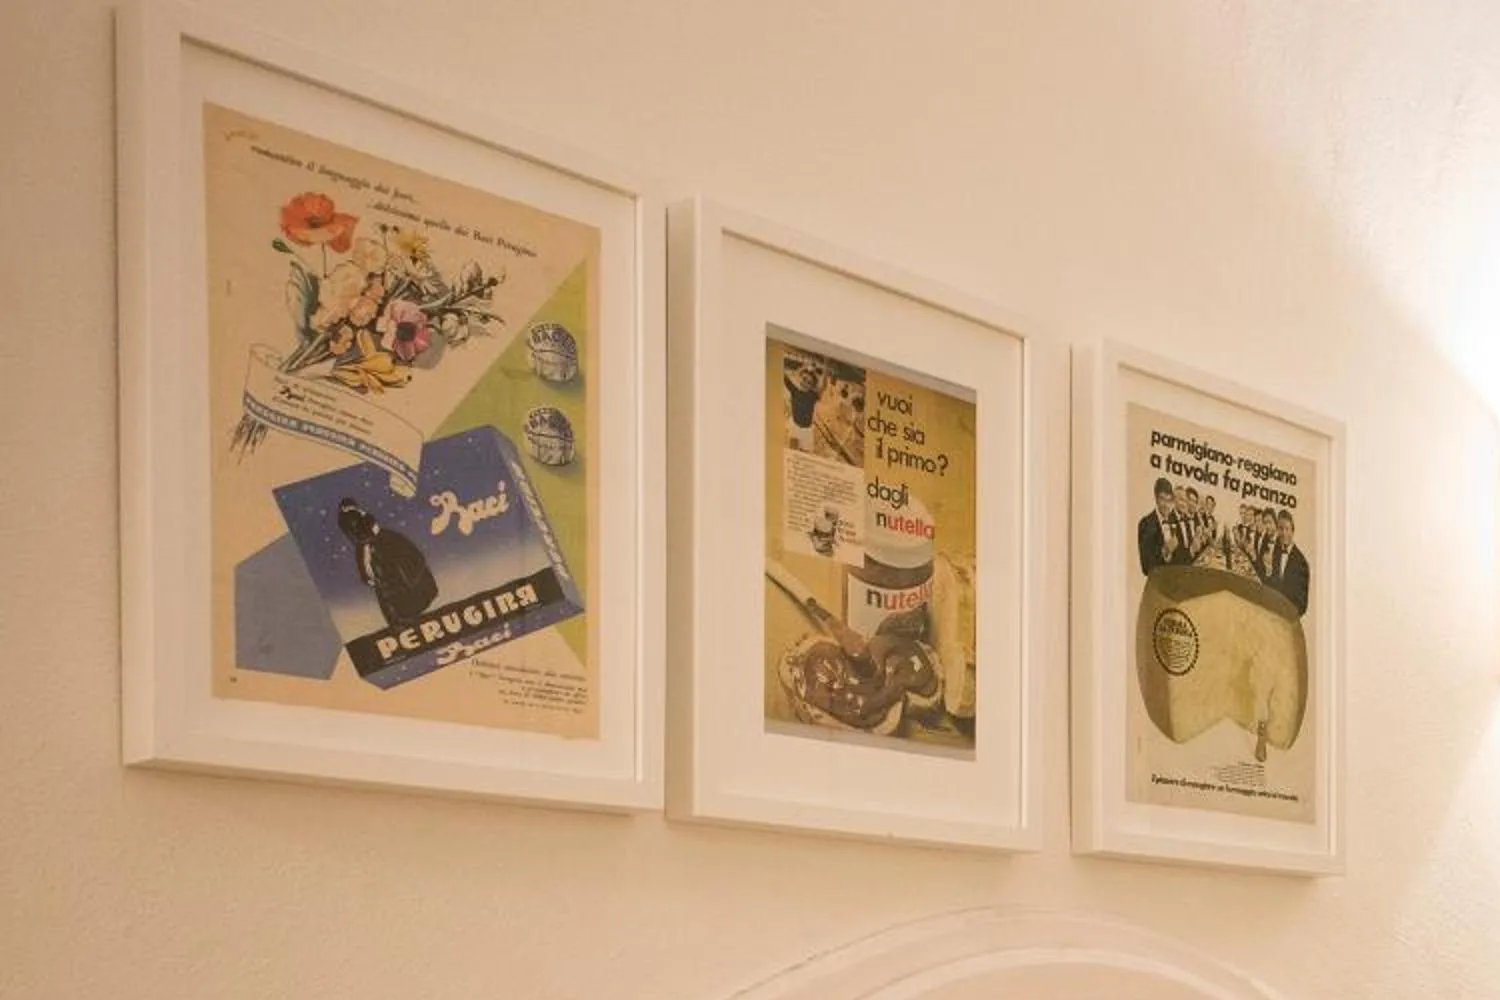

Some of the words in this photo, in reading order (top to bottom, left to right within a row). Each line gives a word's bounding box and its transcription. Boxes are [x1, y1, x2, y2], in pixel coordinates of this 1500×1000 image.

[877, 391, 913, 416] vuoi
[867, 410, 897, 436] che
[903, 420, 925, 446] sia
[887, 447, 949, 477] primo?
[866, 476, 910, 510] dagli
[1150, 453, 1162, 469] a
[1165, 453, 1219, 486] tavola
[1222, 469, 1240, 492] fa
[1241, 480, 1297, 509] pranzo
[876, 511, 936, 540] nutella
[376, 583, 539, 660] PERUGINA
